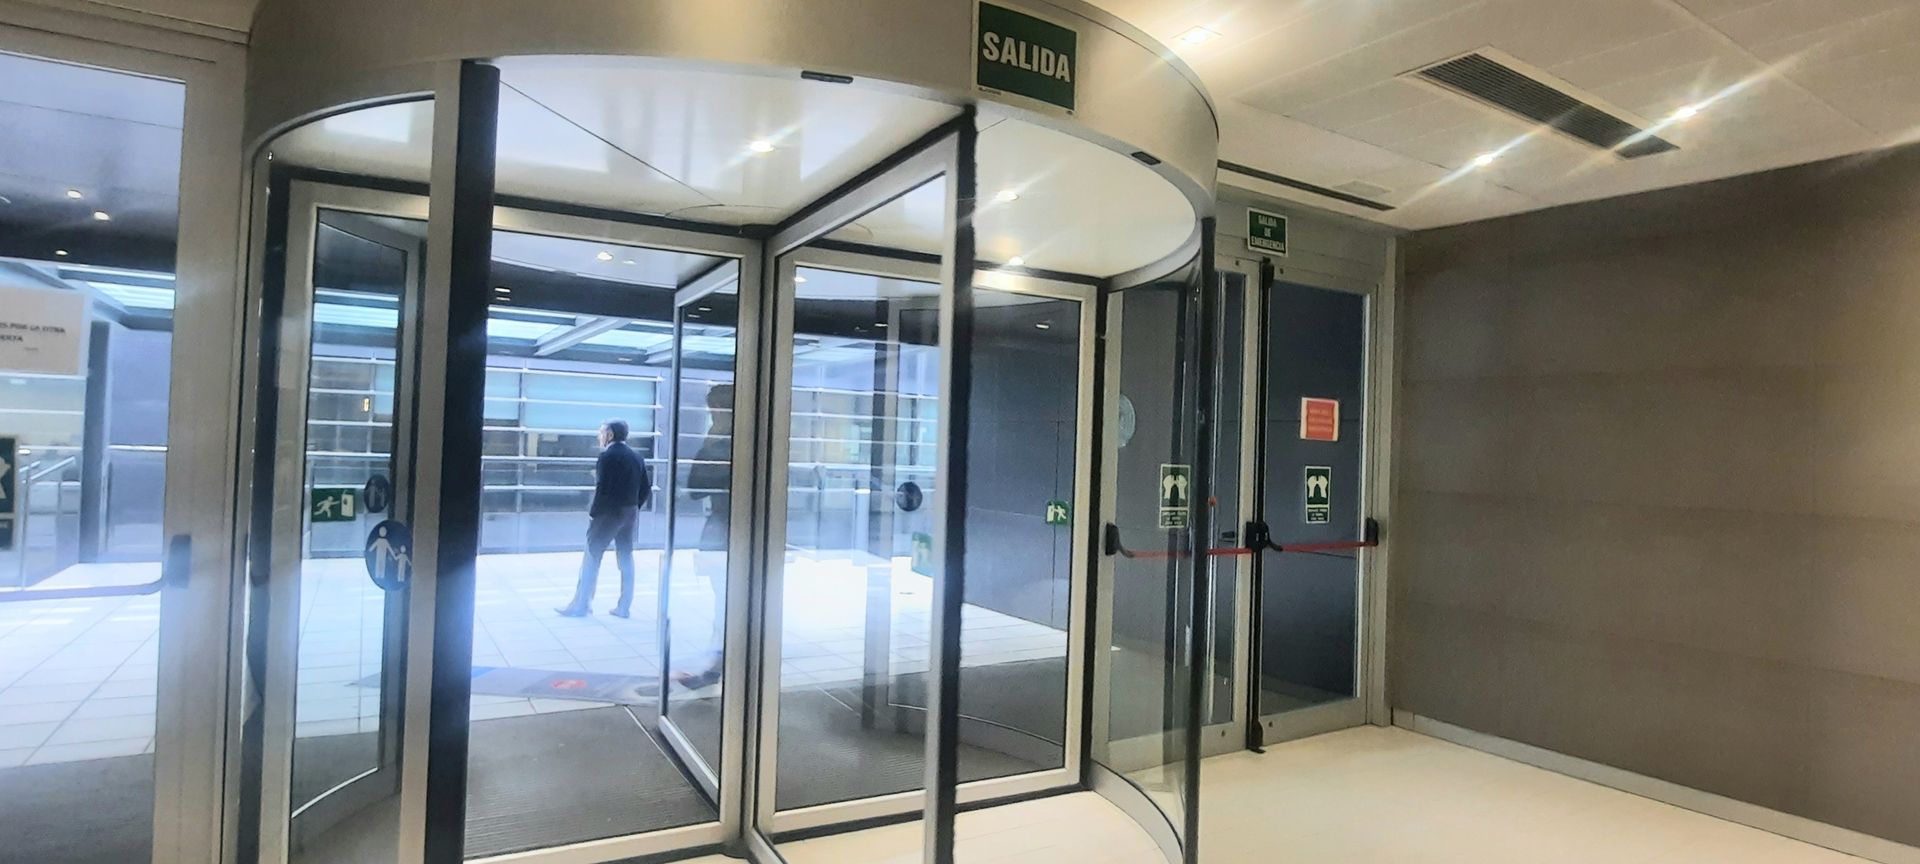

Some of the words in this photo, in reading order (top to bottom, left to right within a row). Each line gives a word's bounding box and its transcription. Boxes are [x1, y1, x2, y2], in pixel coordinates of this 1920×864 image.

[982, 31, 1070, 83] SALIDA
[1258, 214, 1277, 228] SALIDA
[1264, 227, 1271, 238] DE
[1251, 235, 1285, 251] EMERGENCIA
